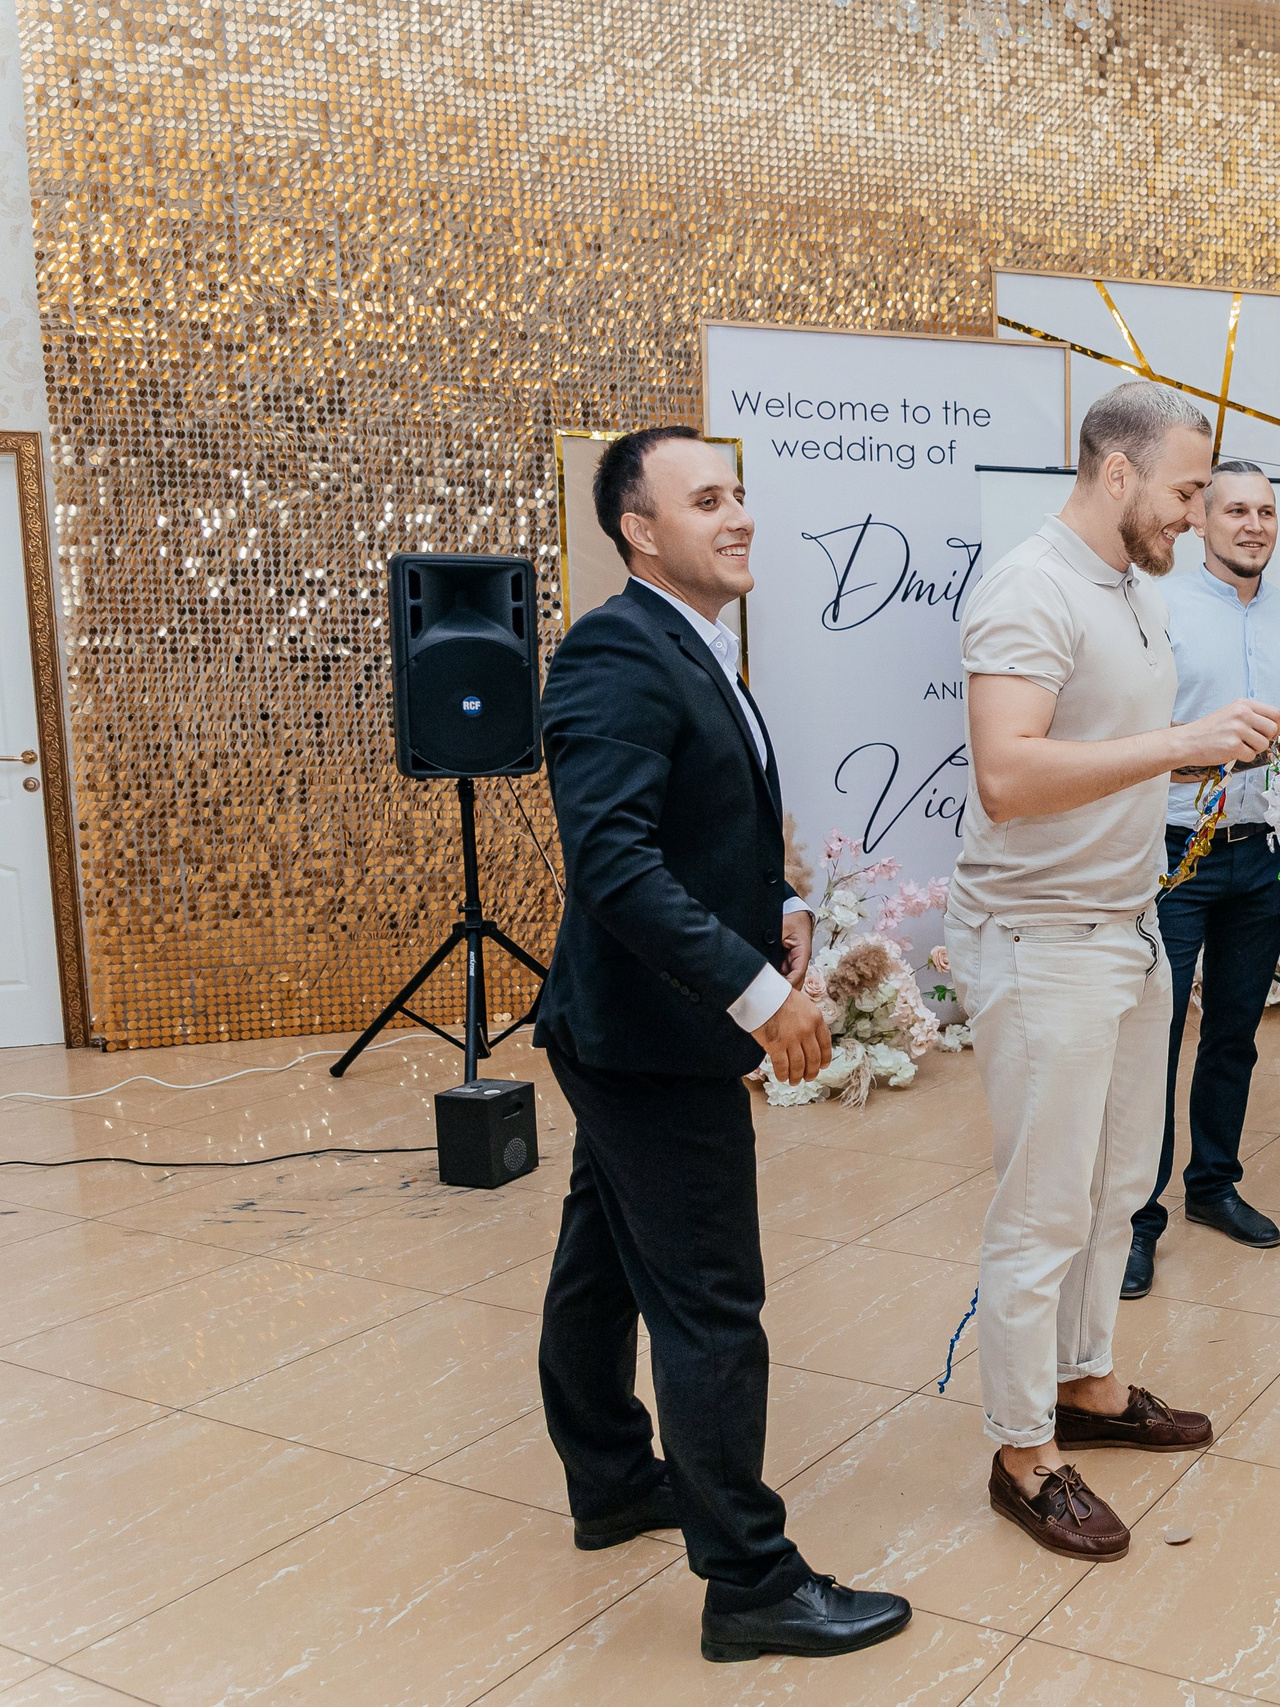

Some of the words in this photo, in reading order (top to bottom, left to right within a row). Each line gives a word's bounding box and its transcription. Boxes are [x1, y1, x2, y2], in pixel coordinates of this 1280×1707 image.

[731, 390, 889, 423] Welcome
[900, 398, 931, 425] to
[942, 400, 991, 427] the
[771, 435, 915, 470] wedding
[927, 439, 957, 464] of
[801, 513, 982, 631] Dmit
[463, 701, 481, 710] RCF
[923, 681, 963, 700] AN
